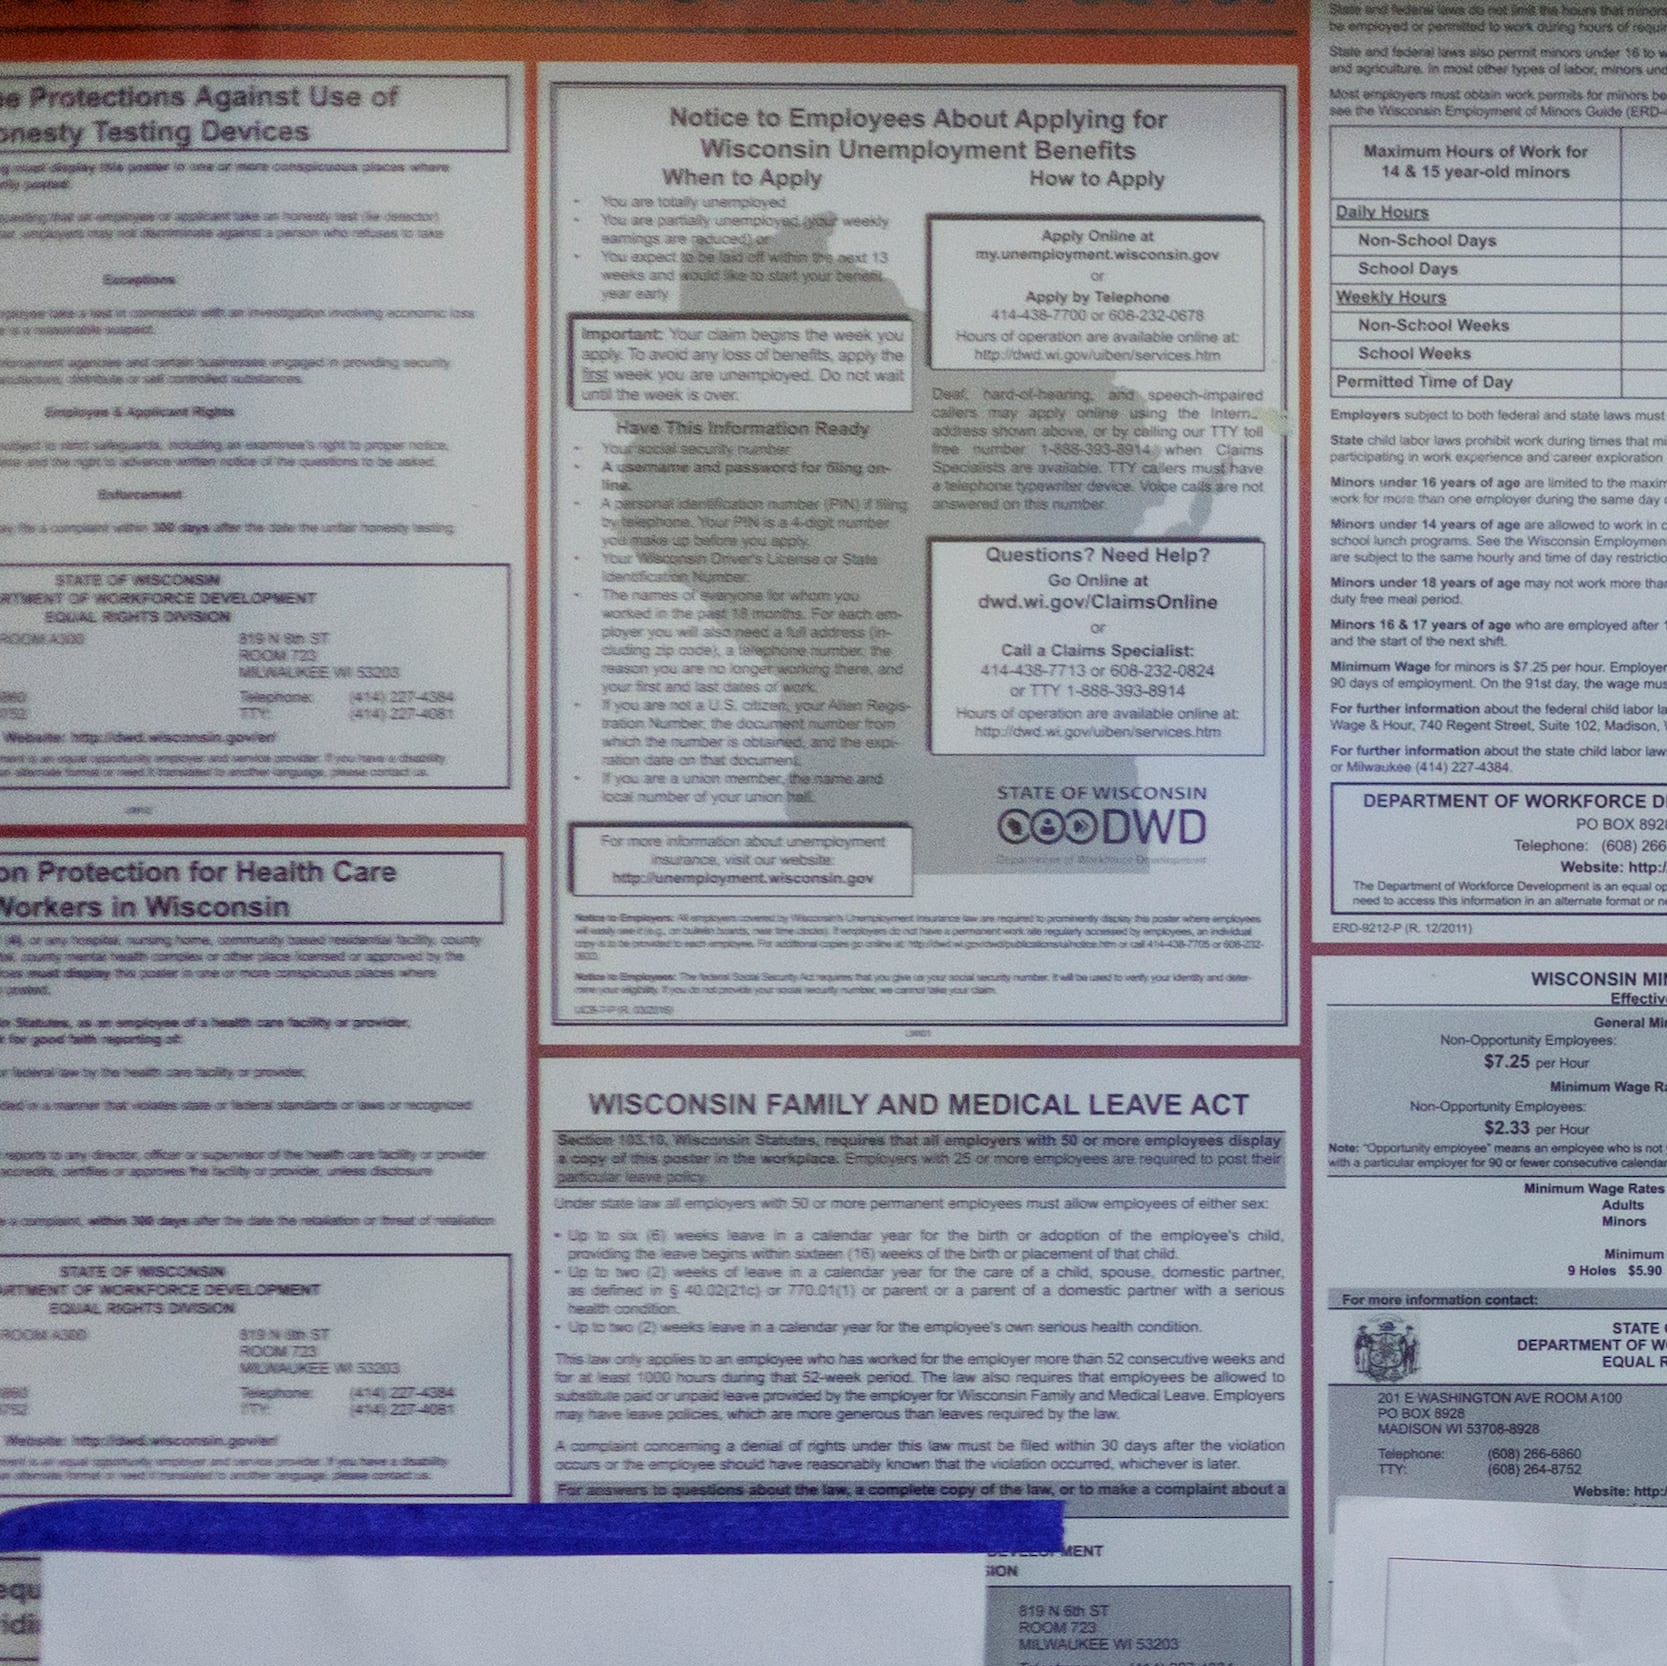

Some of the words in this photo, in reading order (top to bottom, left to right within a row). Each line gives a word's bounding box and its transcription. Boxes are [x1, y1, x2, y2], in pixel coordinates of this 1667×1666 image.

[30, 85, 186, 108] Protections
[195, 85, 300, 113] Against
[310, 85, 362, 107] Use
[371, 85, 399, 107] of
[670, 106, 750, 128] Notice
[756, 108, 782, 128] to
[789, 106, 926, 134] Employees
[932, 107, 1009, 129] About
[1014, 108, 1126, 135] Applying
[1132, 108, 1169, 130] for
[94, 119, 194, 148] Testing
[202, 119, 310, 142] Devices
[700, 138, 831, 160] Wisconsin
[839, 138, 1029, 166] Unemployment
[1034, 138, 1138, 161] Benefits
[1363, 143, 1442, 158] Maximum
[1445, 144, 1495, 159] Hours
[1498, 144, 1516, 159] of
[1518, 144, 1562, 159] Work
[1565, 144, 1589, 159] for
[662, 167, 725, 187] When
[731, 170, 754, 187] to
[759, 168, 823, 191] Apply
[1029, 169, 1076, 187] How
[1080, 171, 1102, 187] to
[1106, 169, 1166, 192] Apply
[978, 593, 1218, 614] dwd.wi.gov/ClaimsOnline
[1363, 793, 1489, 809] DEPARTMENT
[1494, 793, 1519, 809] OF
[1524, 793, 1647, 809] WORKFORCE
[1102, 808, 1206, 845] DWD
[38, 860, 180, 883] Protection
[188, 860, 228, 883] for
[236, 860, 324, 883] Health
[332, 859, 397, 883] Care
[112, 895, 138, 918] in
[145, 894, 290, 918] Wisconsin
[1531, 971, 1637, 987] WISCONSIN
[1483, 1052, 1531, 1070] $7.25
[1535, 1059, 1556, 1071] per
[1559, 1057, 1590, 1069] Hour
[589, 1092, 756, 1116] WISCONSIN
[767, 1093, 869, 1116] FAMILY
[876, 1092, 939, 1116] AND
[949, 1092, 1081, 1116] MEDICAL
[1089, 1093, 1182, 1116] LEAVE
[1190, 1093, 1250, 1116] ACT
